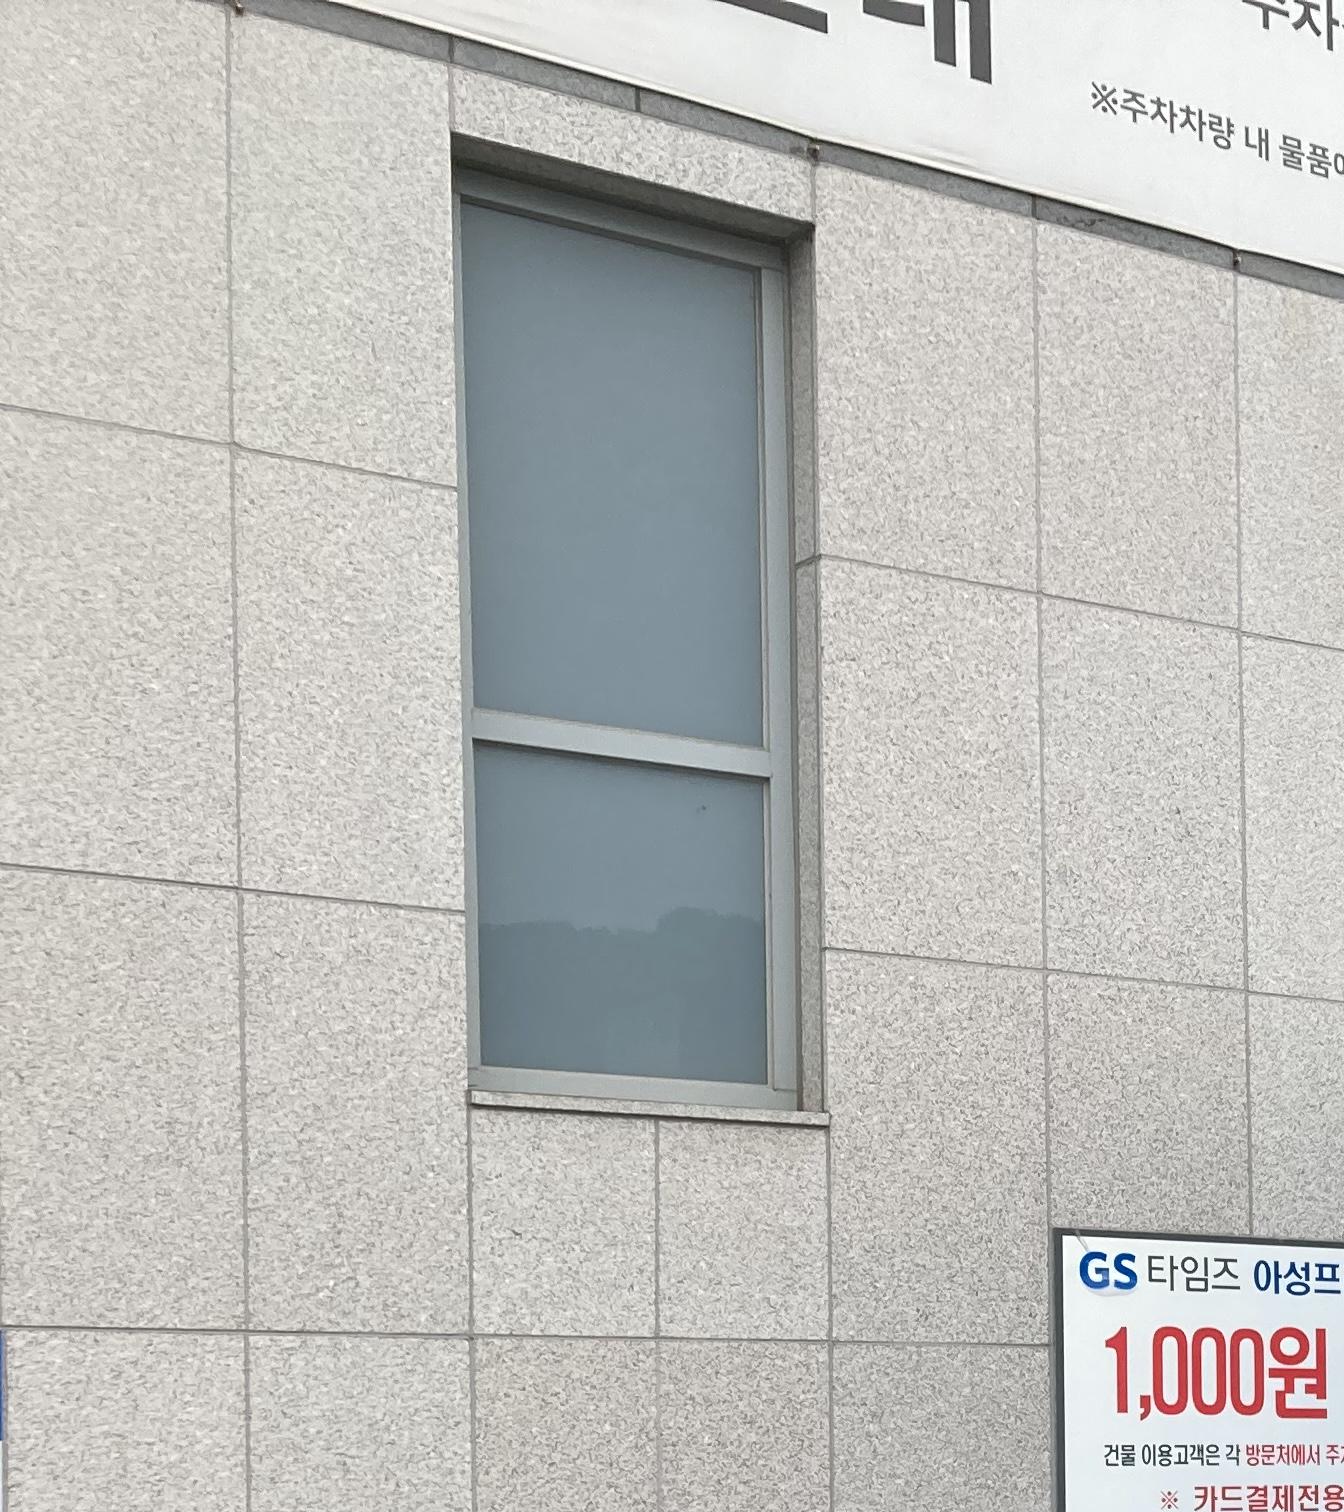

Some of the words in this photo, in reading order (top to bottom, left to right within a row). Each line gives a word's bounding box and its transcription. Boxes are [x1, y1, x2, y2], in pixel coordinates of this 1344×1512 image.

[1244, 124, 1270, 161] 내
[1079, 1251, 1138, 1290] GS
[1147, 1255, 1241, 1292] 타임즈
[1104, 1325, 1329, 1422] 1,000원
[1103, 1443, 1136, 1467] 건물
[1141, 1443, 1221, 1467] 이용고객은
[1225, 1444, 1241, 1467] 각
[1245, 1443, 1321, 1467] 방문처에서
